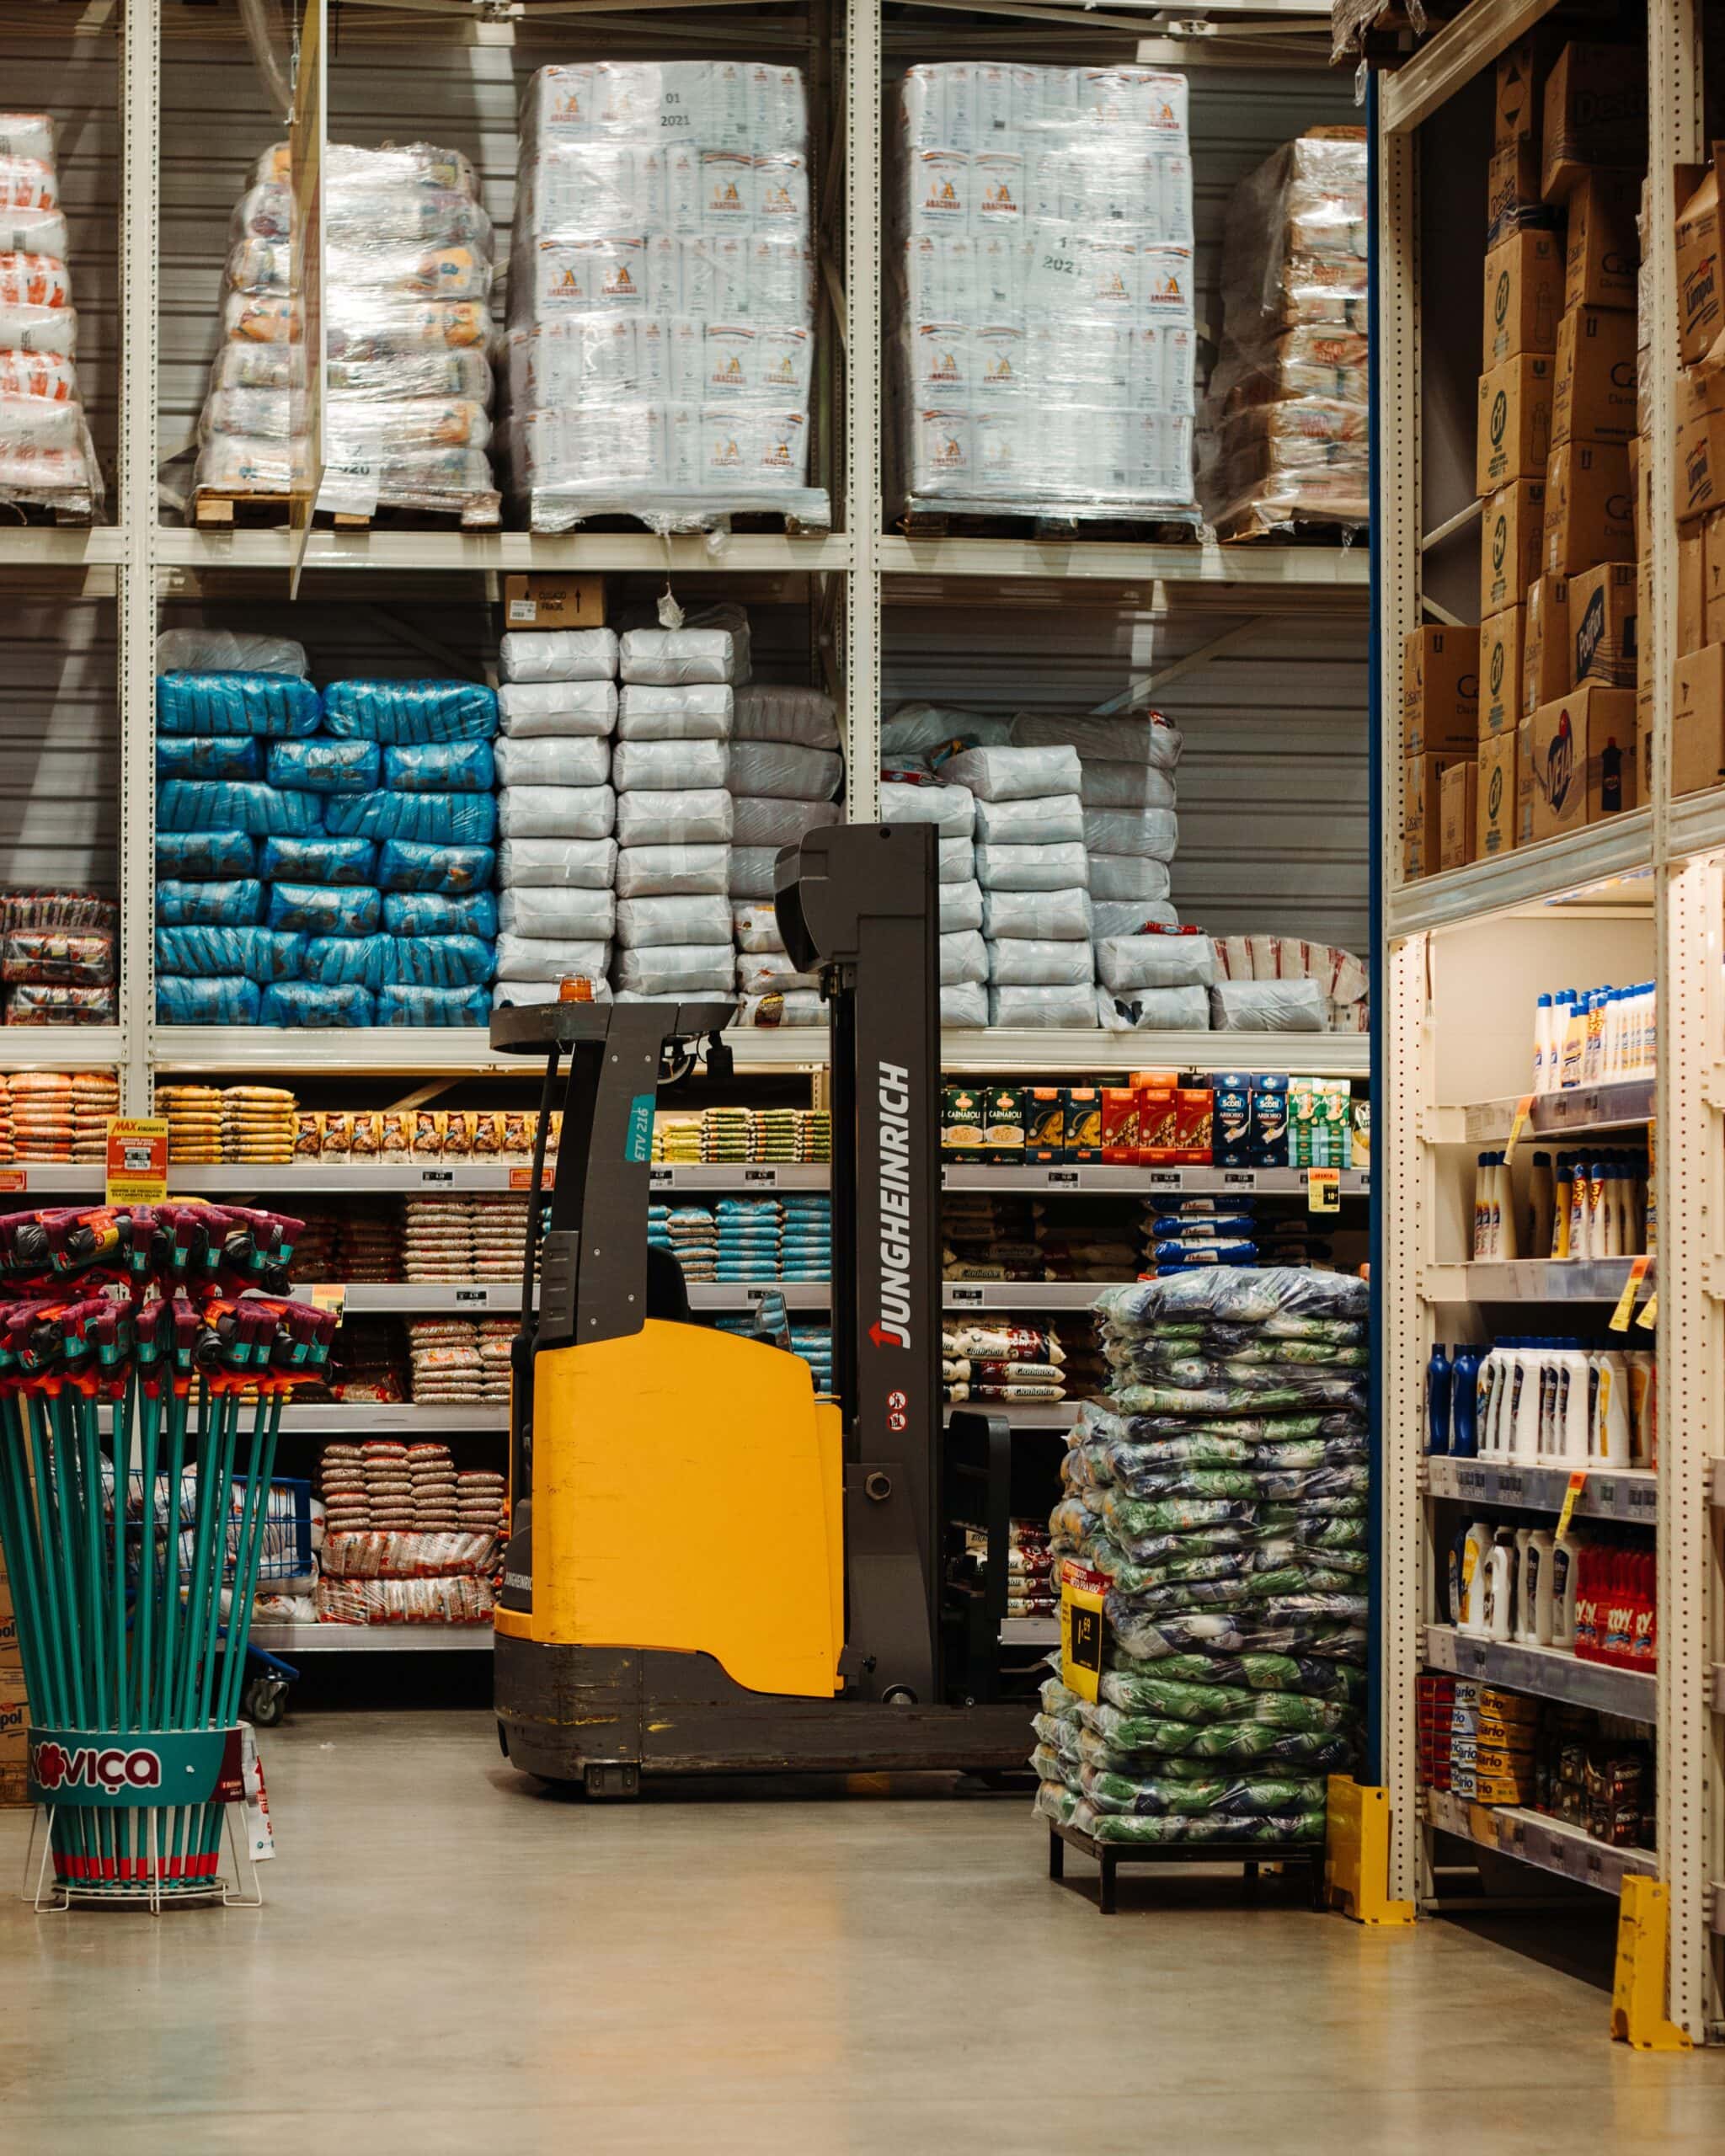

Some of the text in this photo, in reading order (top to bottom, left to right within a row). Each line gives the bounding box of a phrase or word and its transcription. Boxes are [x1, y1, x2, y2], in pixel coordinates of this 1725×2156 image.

[665, 93, 681, 104] 01
[660, 115, 691, 127] 2021
[948, 1111, 981, 1120] CARNAROLI
[989, 1110, 1023, 1119] CARNAROLI
[111, 1121, 137, 1135] MAX
[634, 1107, 649, 1161] ETV 216
[879, 1061, 911, 1349] JUNGHEINRICH
